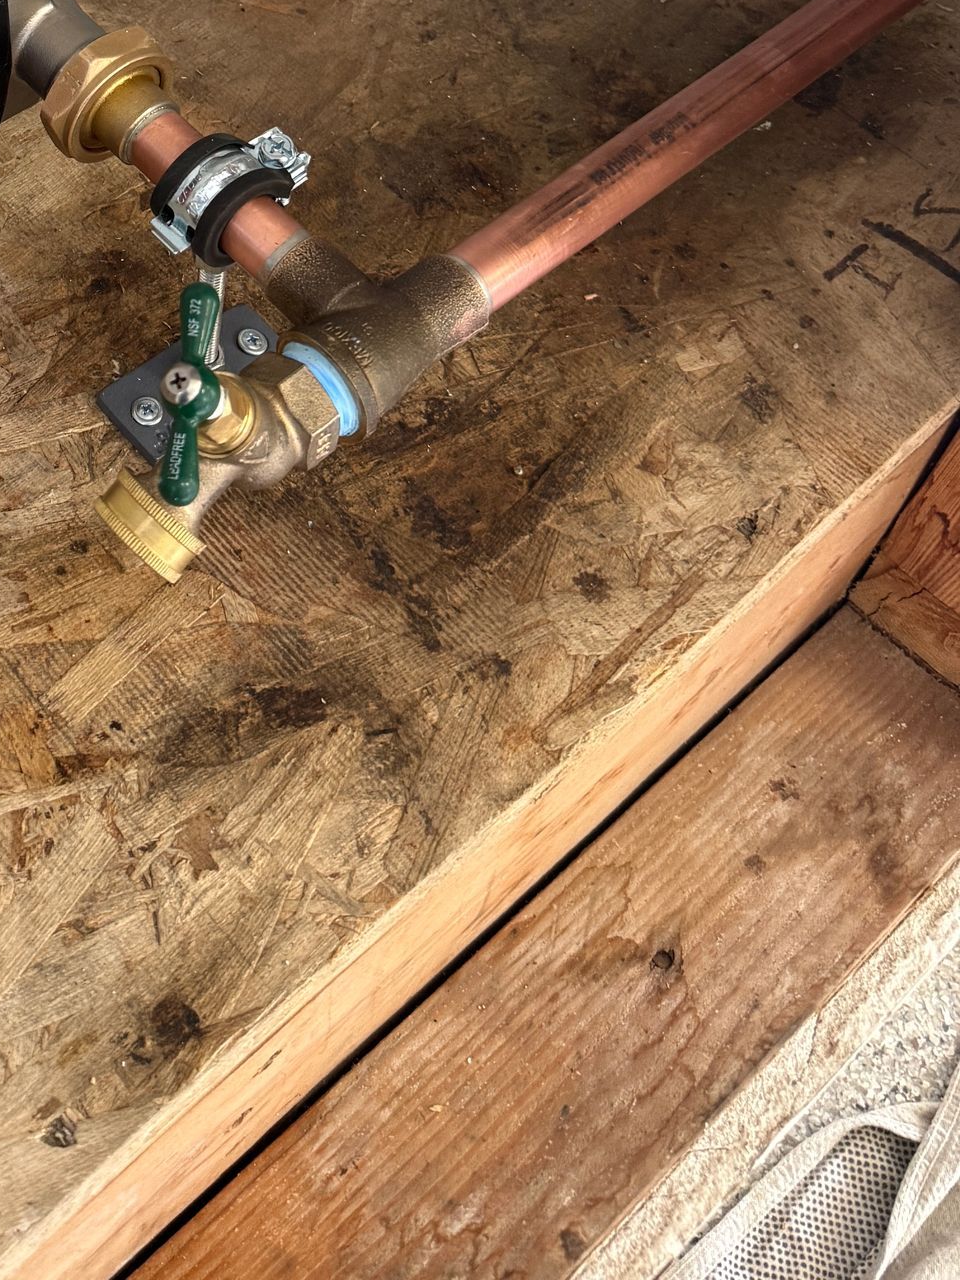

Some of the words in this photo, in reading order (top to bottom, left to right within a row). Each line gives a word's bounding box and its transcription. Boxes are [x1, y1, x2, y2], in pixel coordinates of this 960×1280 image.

[190, 298, 202, 316] 372
[187, 320, 200, 337] NSF
[168, 432, 186, 480] LEADFREE
